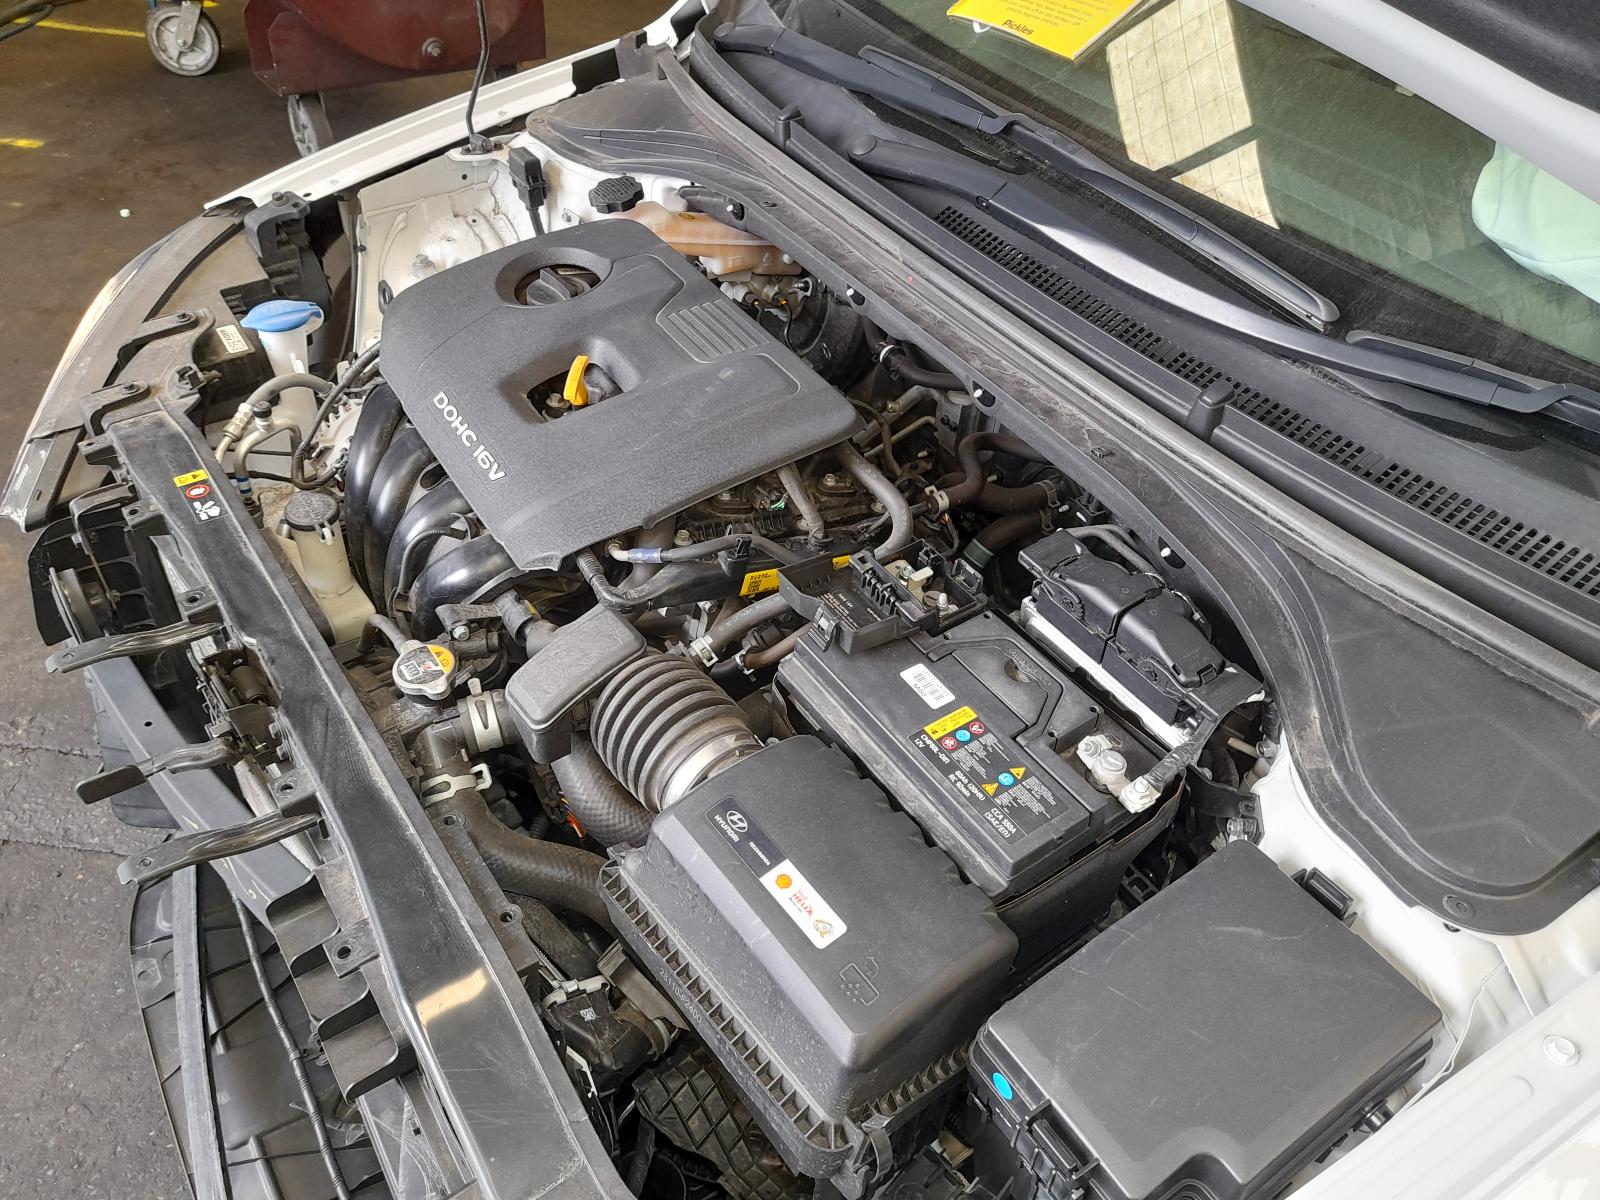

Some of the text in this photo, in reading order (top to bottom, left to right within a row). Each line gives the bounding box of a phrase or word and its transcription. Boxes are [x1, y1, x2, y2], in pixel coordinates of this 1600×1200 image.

[1002, 19, 1034, 36] Pickles
[433, 391, 507, 481] DOHC 16V
[914, 738, 926, 749] 12V
[948, 773, 971, 798] RC 92min
[954, 770, 986, 801] 60Ah (20HR)
[714, 814, 740, 843] HYUNDAI
[991, 807, 1017, 835] CCA 550A
[792, 892, 814, 917] HELIX
[659, 968, 703, 1024] 28110-F2400
